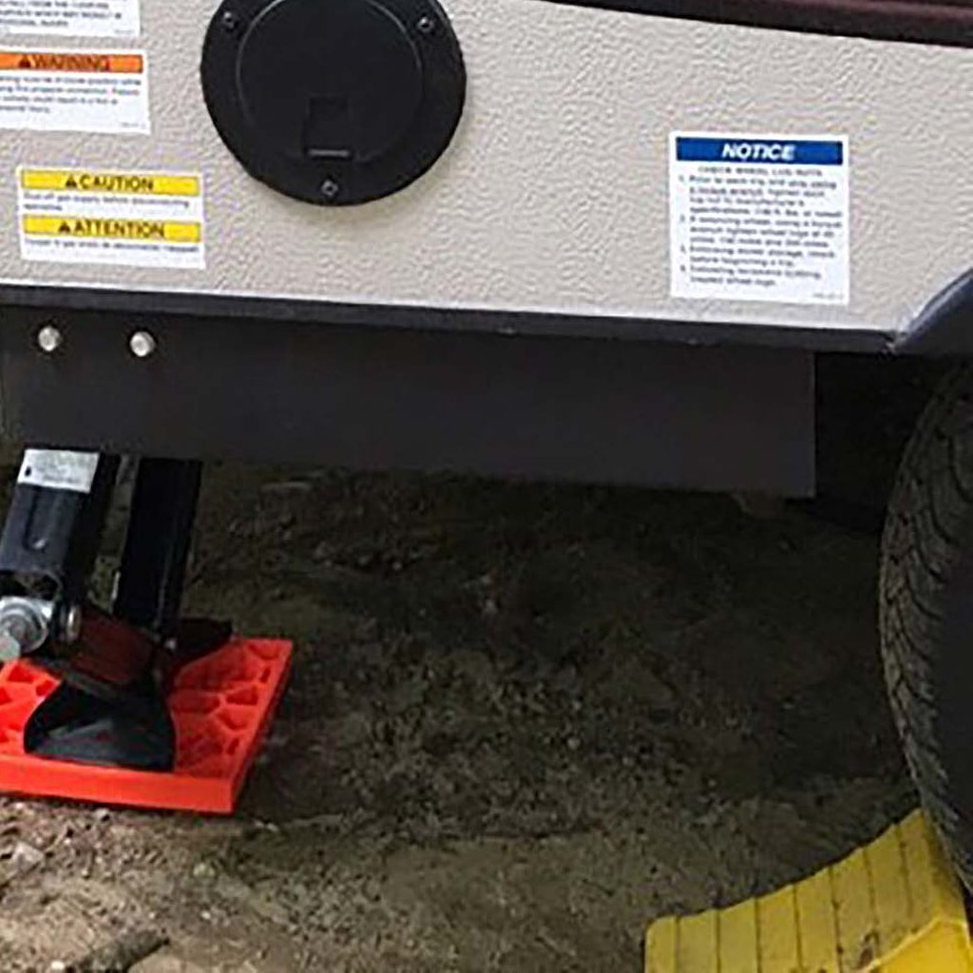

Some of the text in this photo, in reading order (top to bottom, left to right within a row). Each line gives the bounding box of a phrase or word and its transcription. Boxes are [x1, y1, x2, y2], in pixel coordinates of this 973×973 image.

[32, 53, 111, 72] WARNING
[722, 142, 796, 161] NOTICE
[79, 174, 154, 191] CAUTION
[73, 219, 166, 238] ATTENTION
